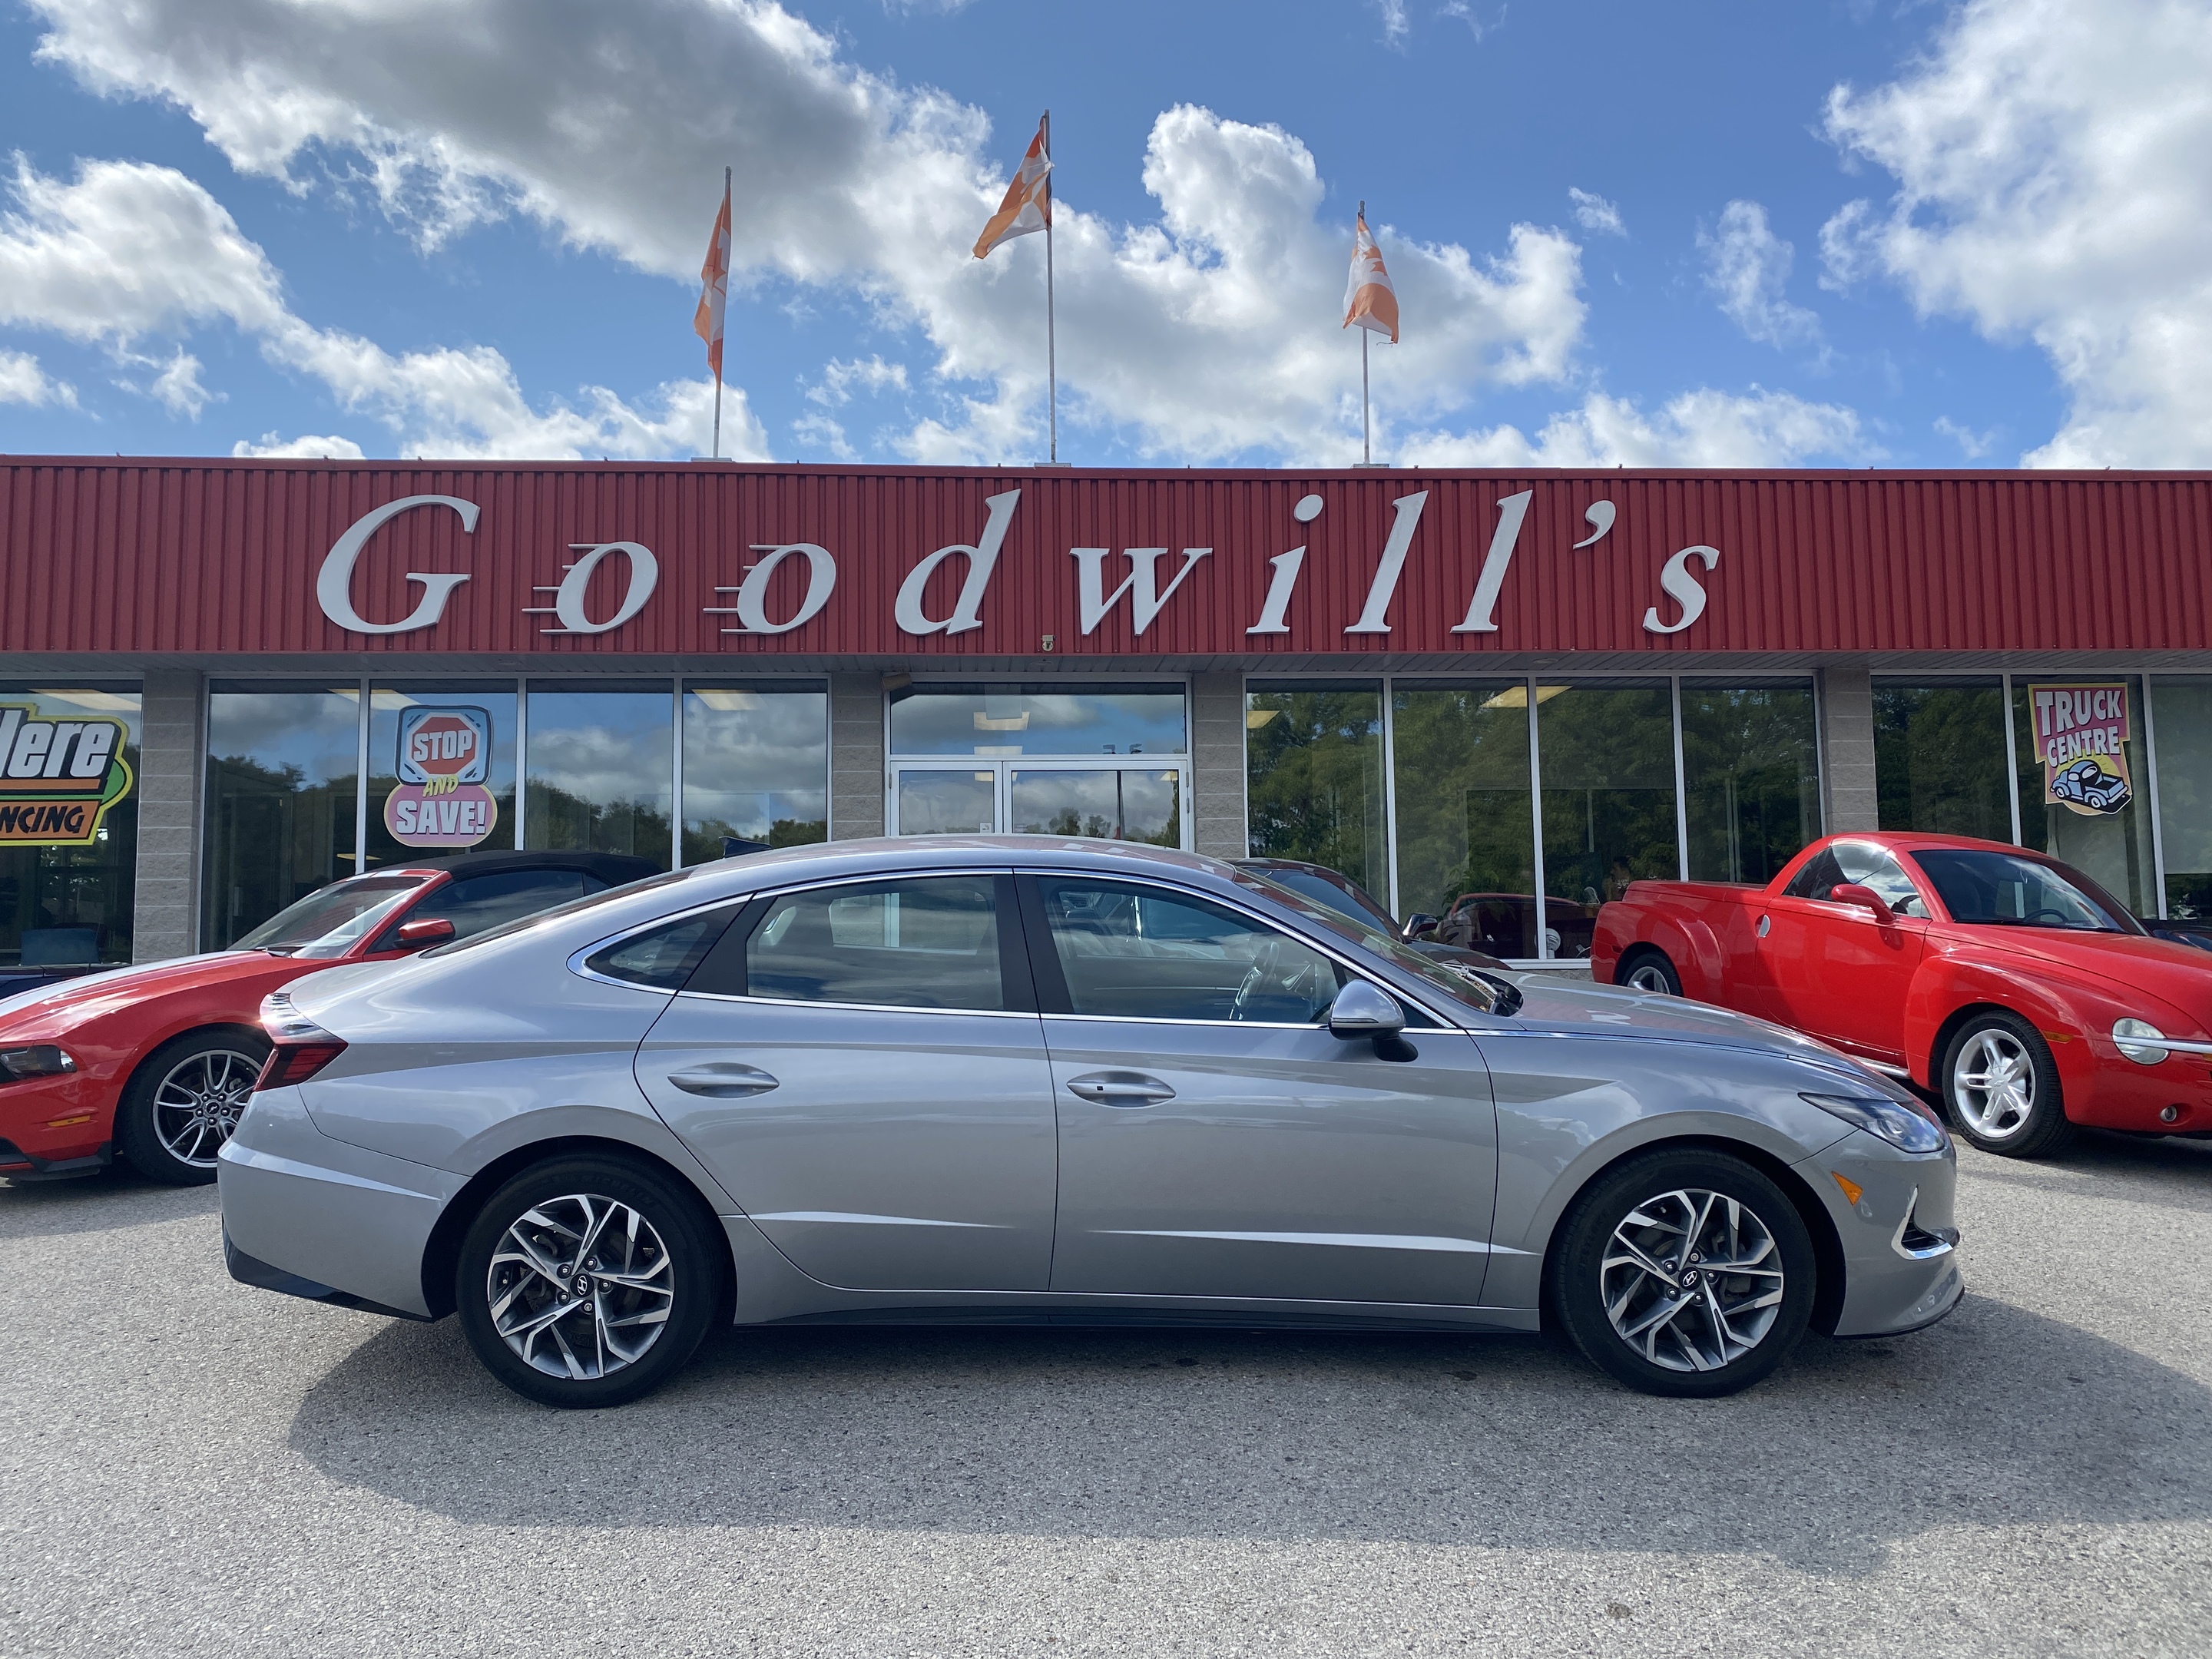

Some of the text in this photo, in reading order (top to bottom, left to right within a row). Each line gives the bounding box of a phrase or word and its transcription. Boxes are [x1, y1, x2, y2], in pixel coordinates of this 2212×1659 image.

[316, 488, 1720, 637] Goodwill's
[2035, 689, 2124, 737] TRUCK
[413, 730, 473, 763] STOP
[2046, 725, 2121, 768] CENTRE
[422, 774, 460, 798] AND
[396, 800, 487, 835] SAVE!
